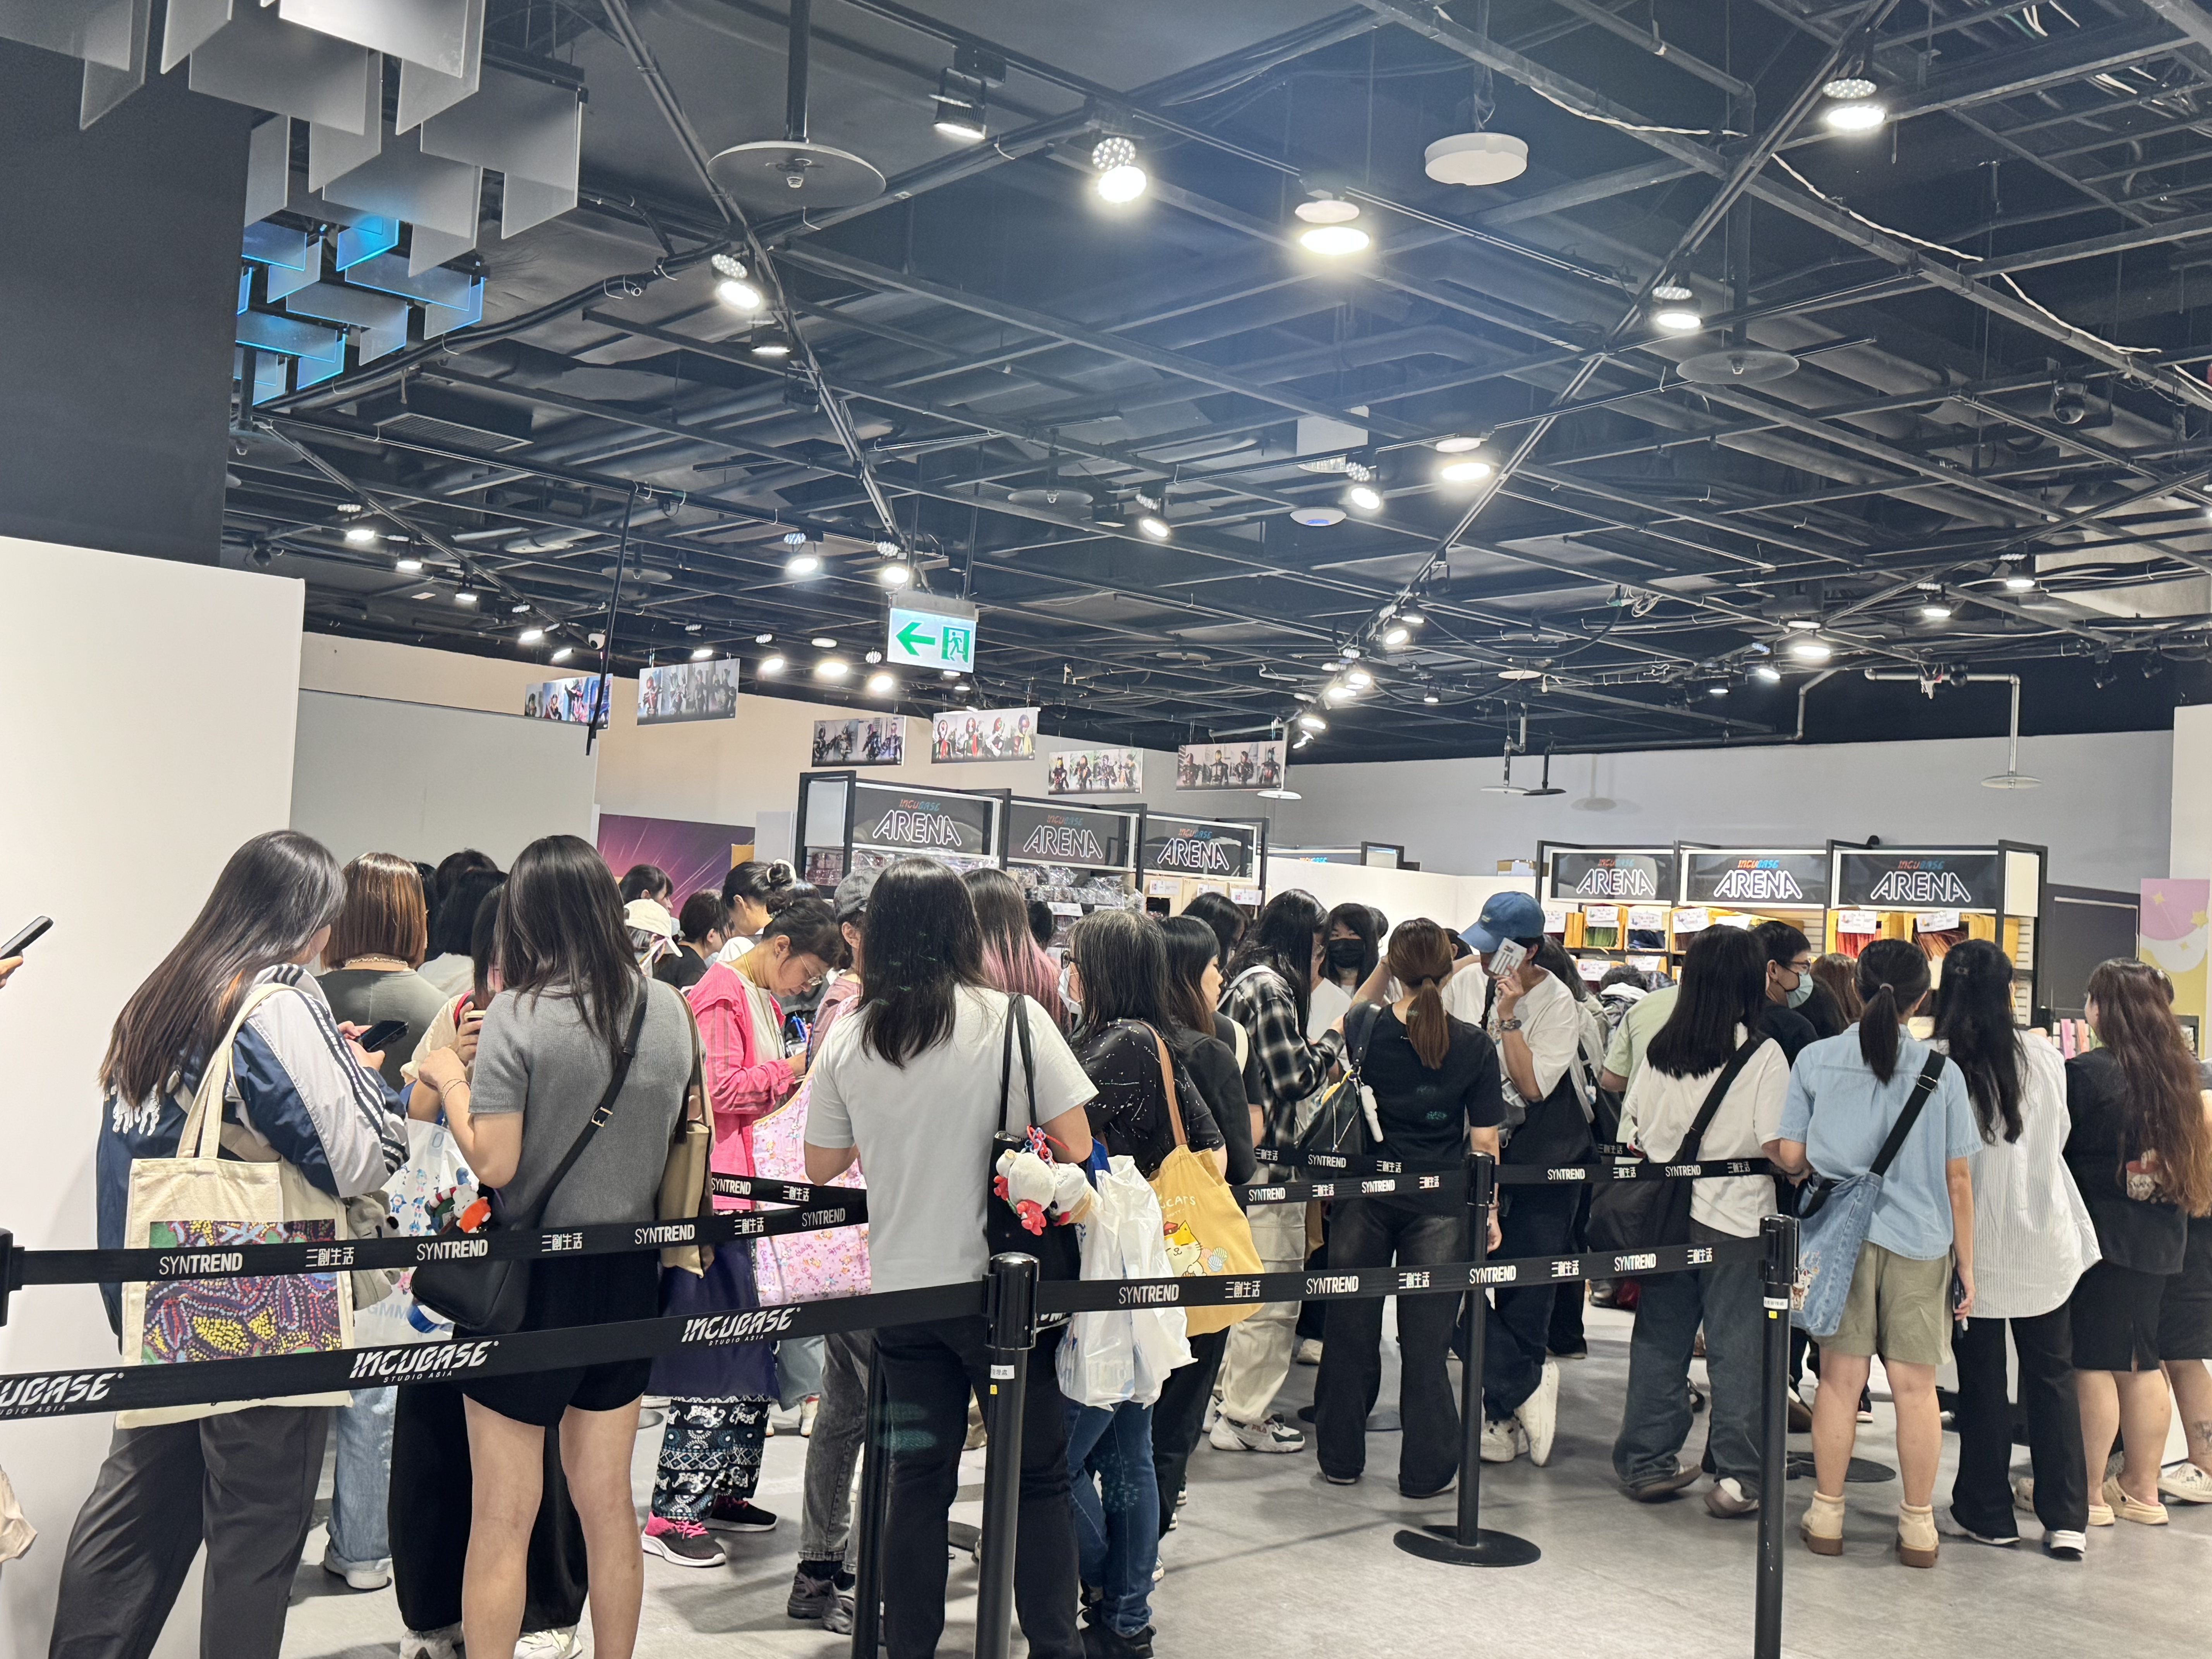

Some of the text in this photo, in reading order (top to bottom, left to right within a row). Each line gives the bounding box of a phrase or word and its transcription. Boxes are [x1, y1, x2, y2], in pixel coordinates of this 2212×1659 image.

[899, 799, 941, 811] INCUBASE
[872, 810, 962, 846] ARENA
[1023, 825, 1103, 859] ARENA
[1158, 838, 1229, 870] ARENA
[1738, 860, 1779, 868] INCUBASE
[1898, 860, 1945, 869] INCUBASE
[1576, 868, 1656, 896] ARENA
[1714, 870, 1802, 899] ARENA
[1870, 871, 1971, 903] ARENA
[1308, 1154, 1346, 1168] SYNTREND
[1547, 1168, 1585, 1180] SYNTREND
[1666, 1165, 1701, 1176] SYNTREND
[712, 1178, 751, 1195] SYNTREND
[783, 1185, 810, 1202] 三創生活
[1249, 1188, 1285, 1201] SYNTREND
[1362, 1180, 1395, 1193] SYNTREND
[735, 1217, 764, 1235] 三創生活
[802, 1208, 845, 1227] SYNTREND
[542, 1233, 582, 1252] 三創生活
[635, 1224, 695, 1244] SYNTREND
[306, 1247, 354, 1267] 三創生活
[417, 1240, 488, 1261] SYNTREND
[160, 1252, 243, 1276] SYNTREND
[1614, 1254, 1656, 1271] SYNTREND
[1399, 1272, 1430, 1289] 三創生活
[1469, 1266, 1516, 1284] SYNTREND
[1225, 1280, 1261, 1298] 三創生活
[1306, 1276, 1358, 1294] SYNTREND
[1119, 1285, 1179, 1304] SYNTREND
[681, 1307, 796, 1342] INCUBASE
[709, 1337, 740, 1346] STUDIO
[349, 1341, 492, 1379] INCUBASE
[384, 1374, 422, 1383] STUDIO
[0, 1373, 116, 1407] UBASE
